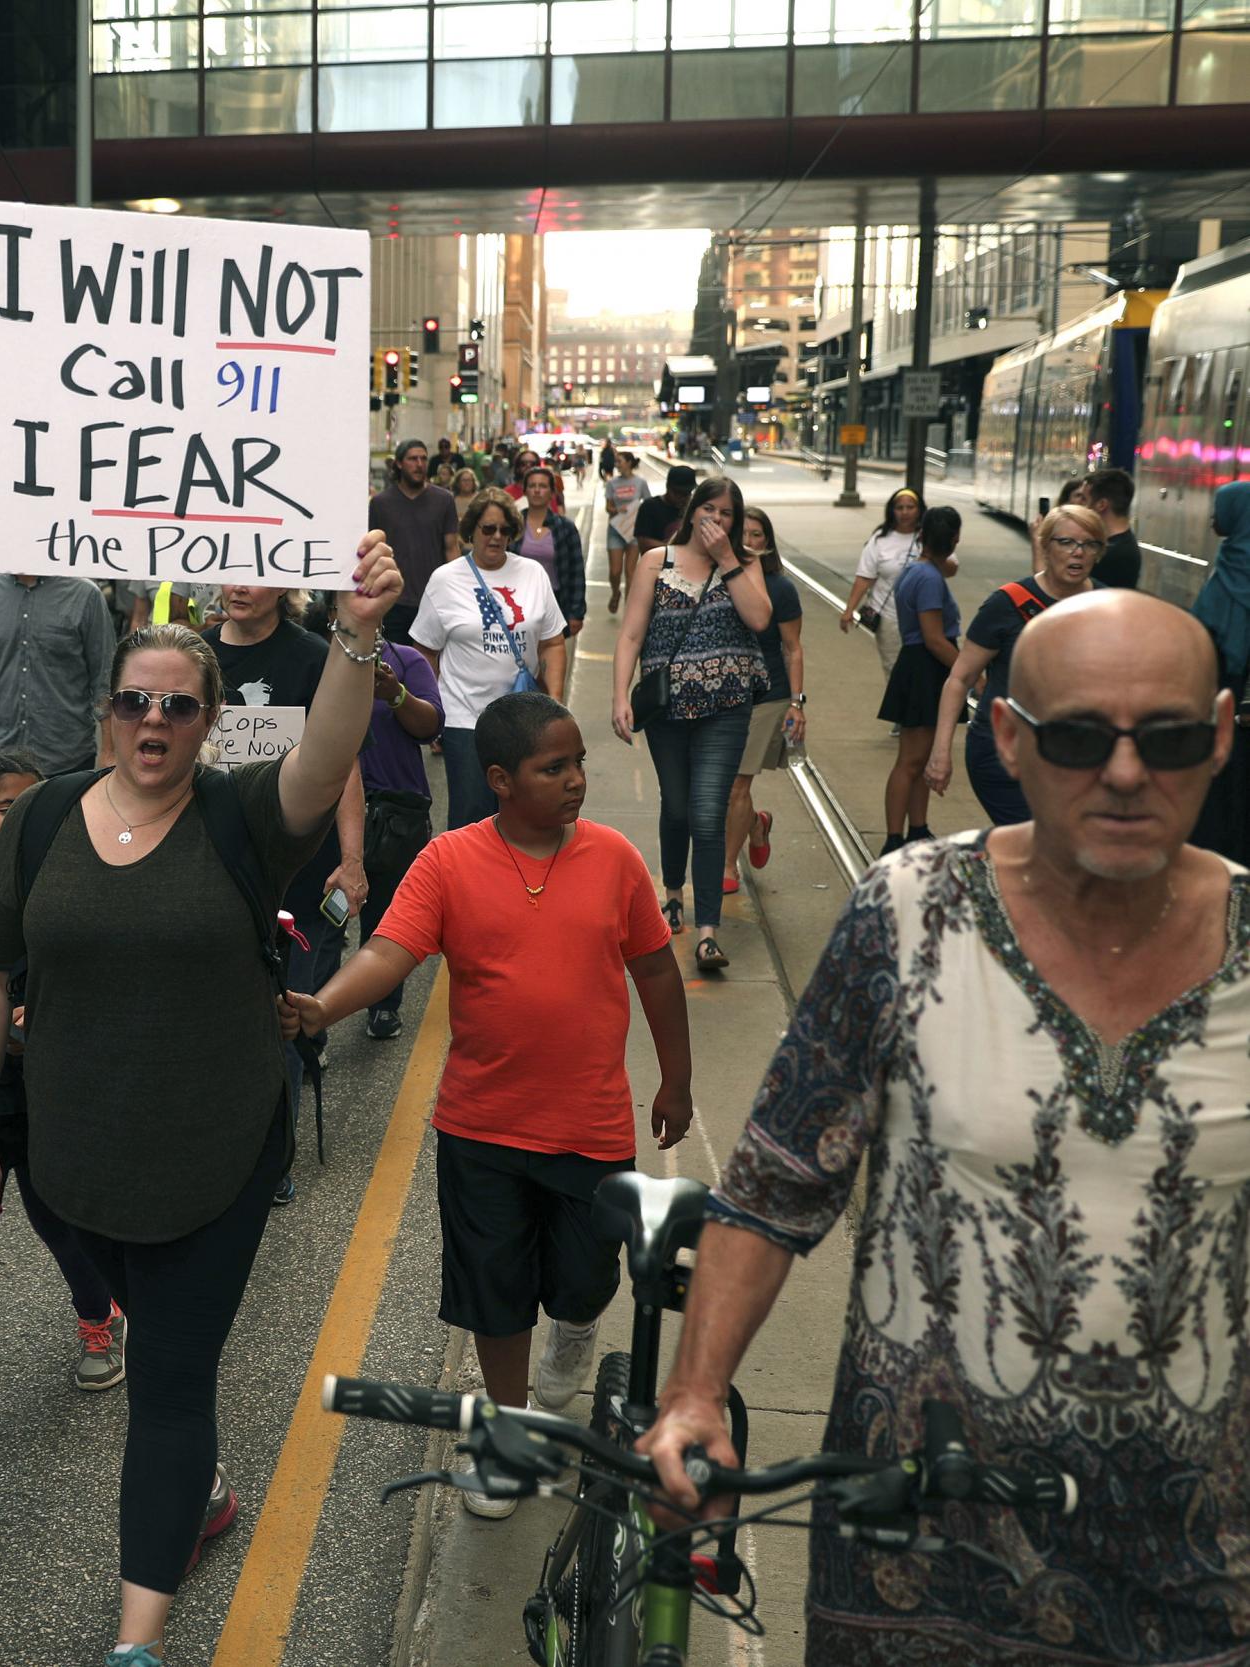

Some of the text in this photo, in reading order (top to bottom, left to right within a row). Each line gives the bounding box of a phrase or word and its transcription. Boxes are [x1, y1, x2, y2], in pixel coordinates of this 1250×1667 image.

[60, 238, 190, 337] Will
[220, 245, 363, 342] NOT
[60, 343, 281, 414] Call 911
[12, 419, 314, 519] I FEAR
[35, 518, 128, 572] the
[147, 526, 341, 577] POLICE
[482, 631, 506, 643] PINK
[483, 642, 526, 655] PATRTS
[217, 710, 277, 738] Cops
[216, 739, 240, 754] re
